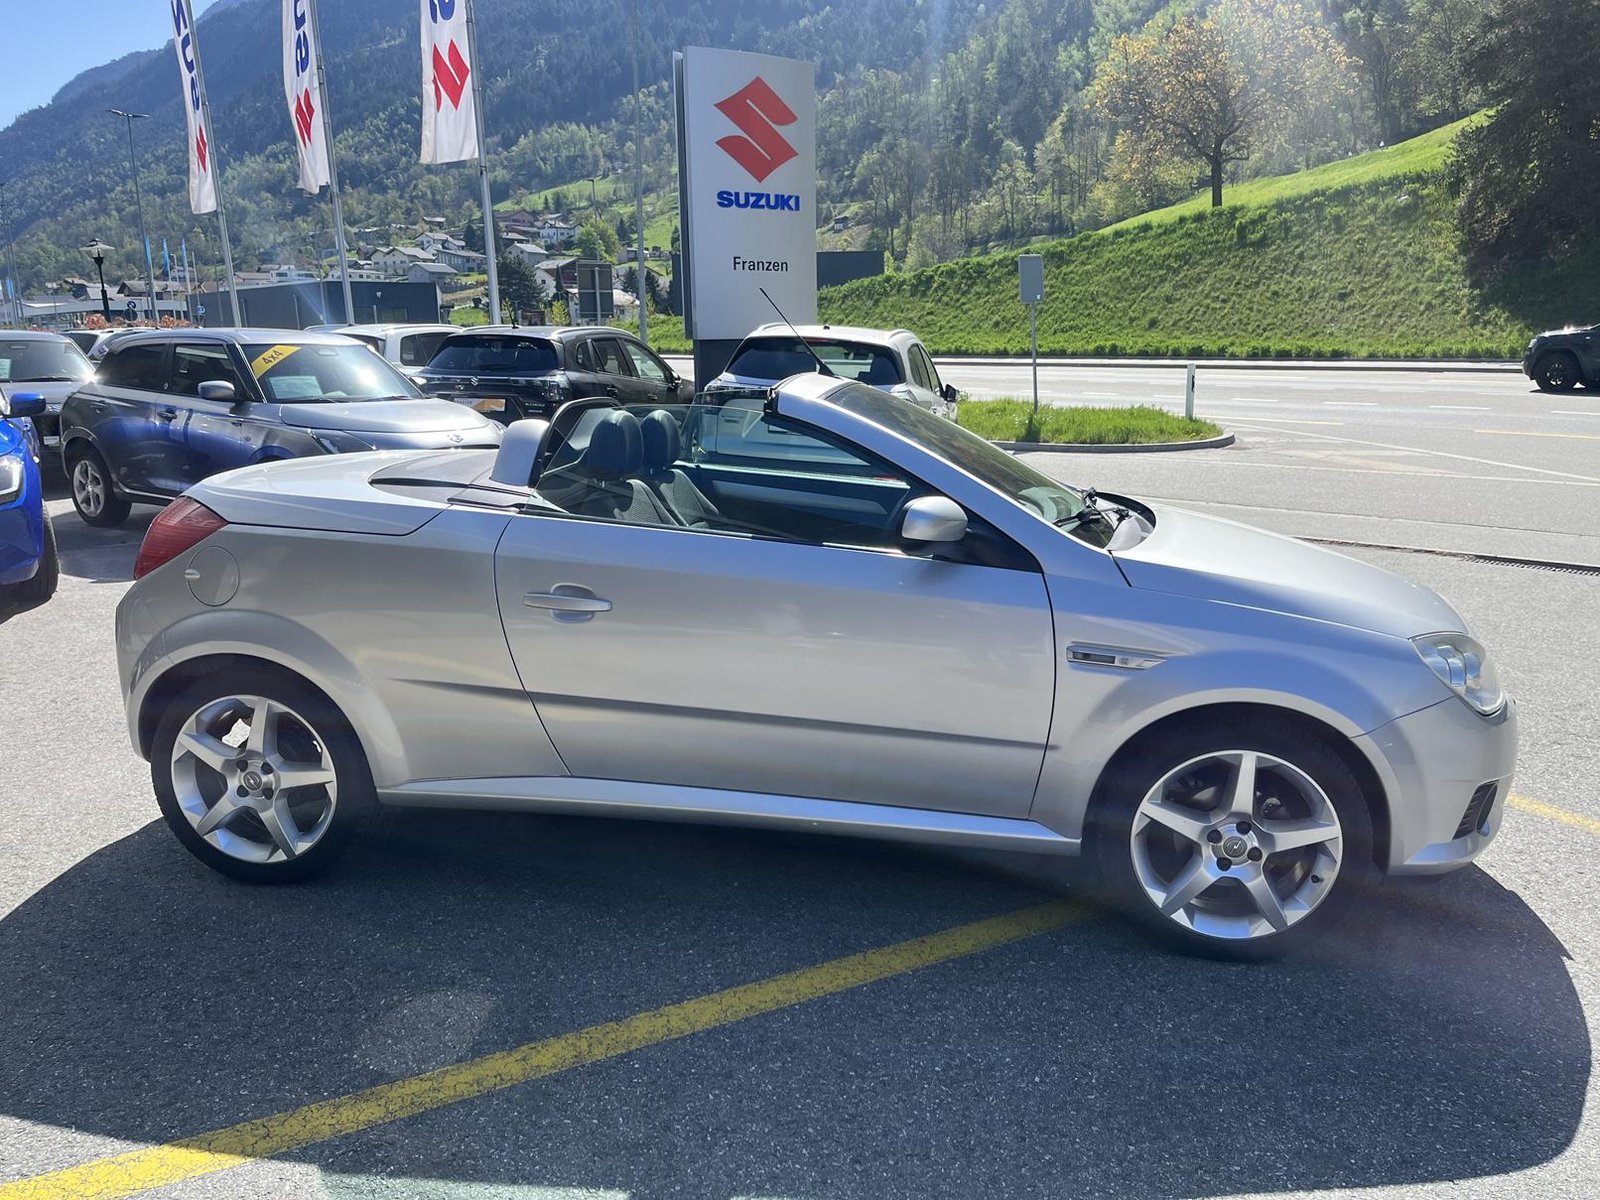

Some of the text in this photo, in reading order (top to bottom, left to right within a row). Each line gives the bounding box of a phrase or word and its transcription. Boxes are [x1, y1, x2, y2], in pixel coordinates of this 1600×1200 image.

[716, 190, 801, 211] SUZUKI
[733, 256, 789, 272] Franzen
[262, 349, 284, 364] 4x4
